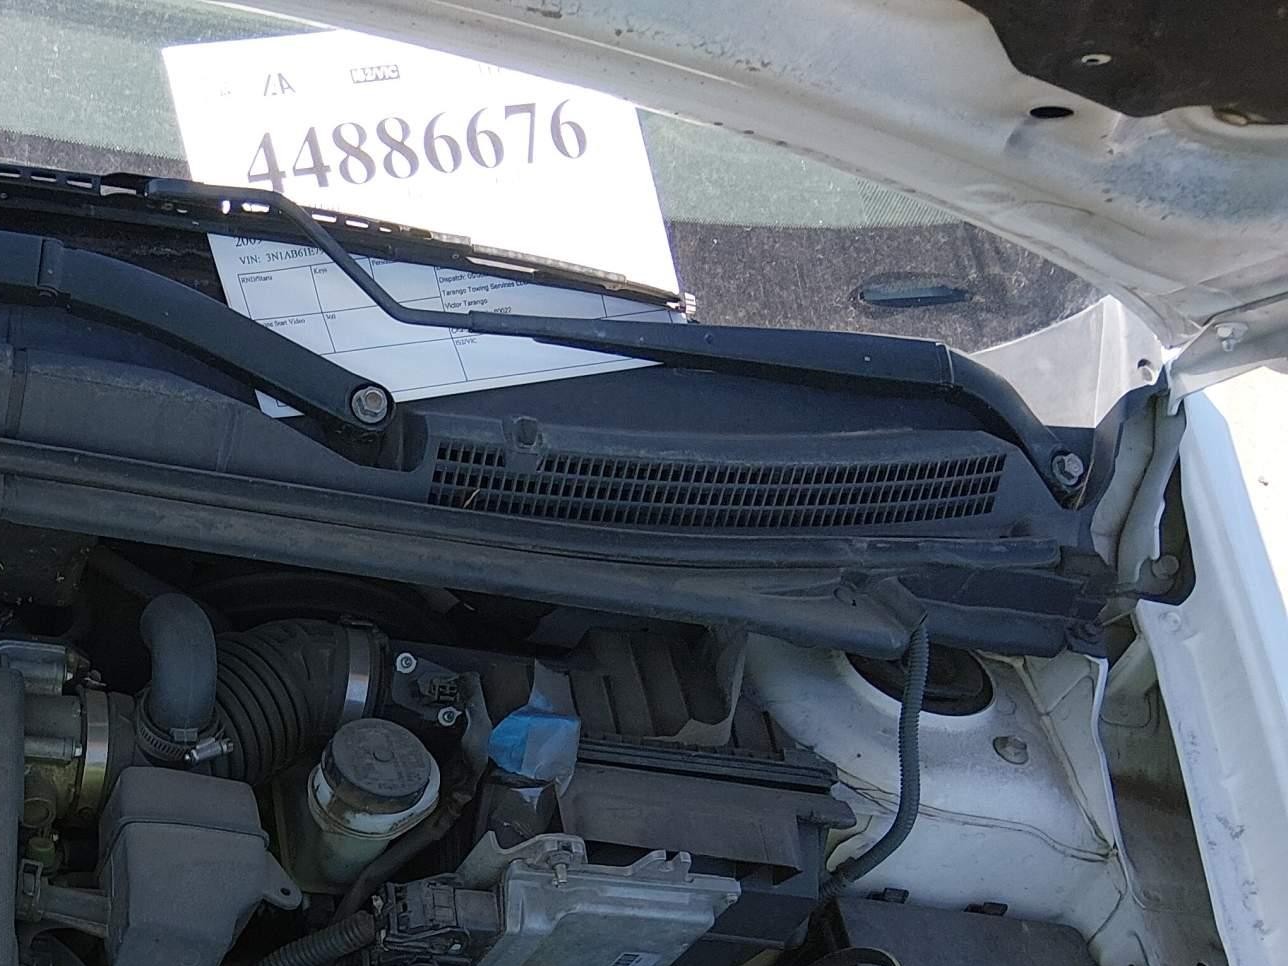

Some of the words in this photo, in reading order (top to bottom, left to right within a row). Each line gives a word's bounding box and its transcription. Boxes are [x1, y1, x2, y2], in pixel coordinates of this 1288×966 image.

[246, 99, 587, 193] 44886676
[239, 255, 260, 265] VIN:
[442, 288, 467, 297] Tarango
[468, 284, 489, 293] Towing
[490, 281, 515, 290] Services
[445, 301, 462, 309] Victor
[464, 298, 488, 307] Tarango
